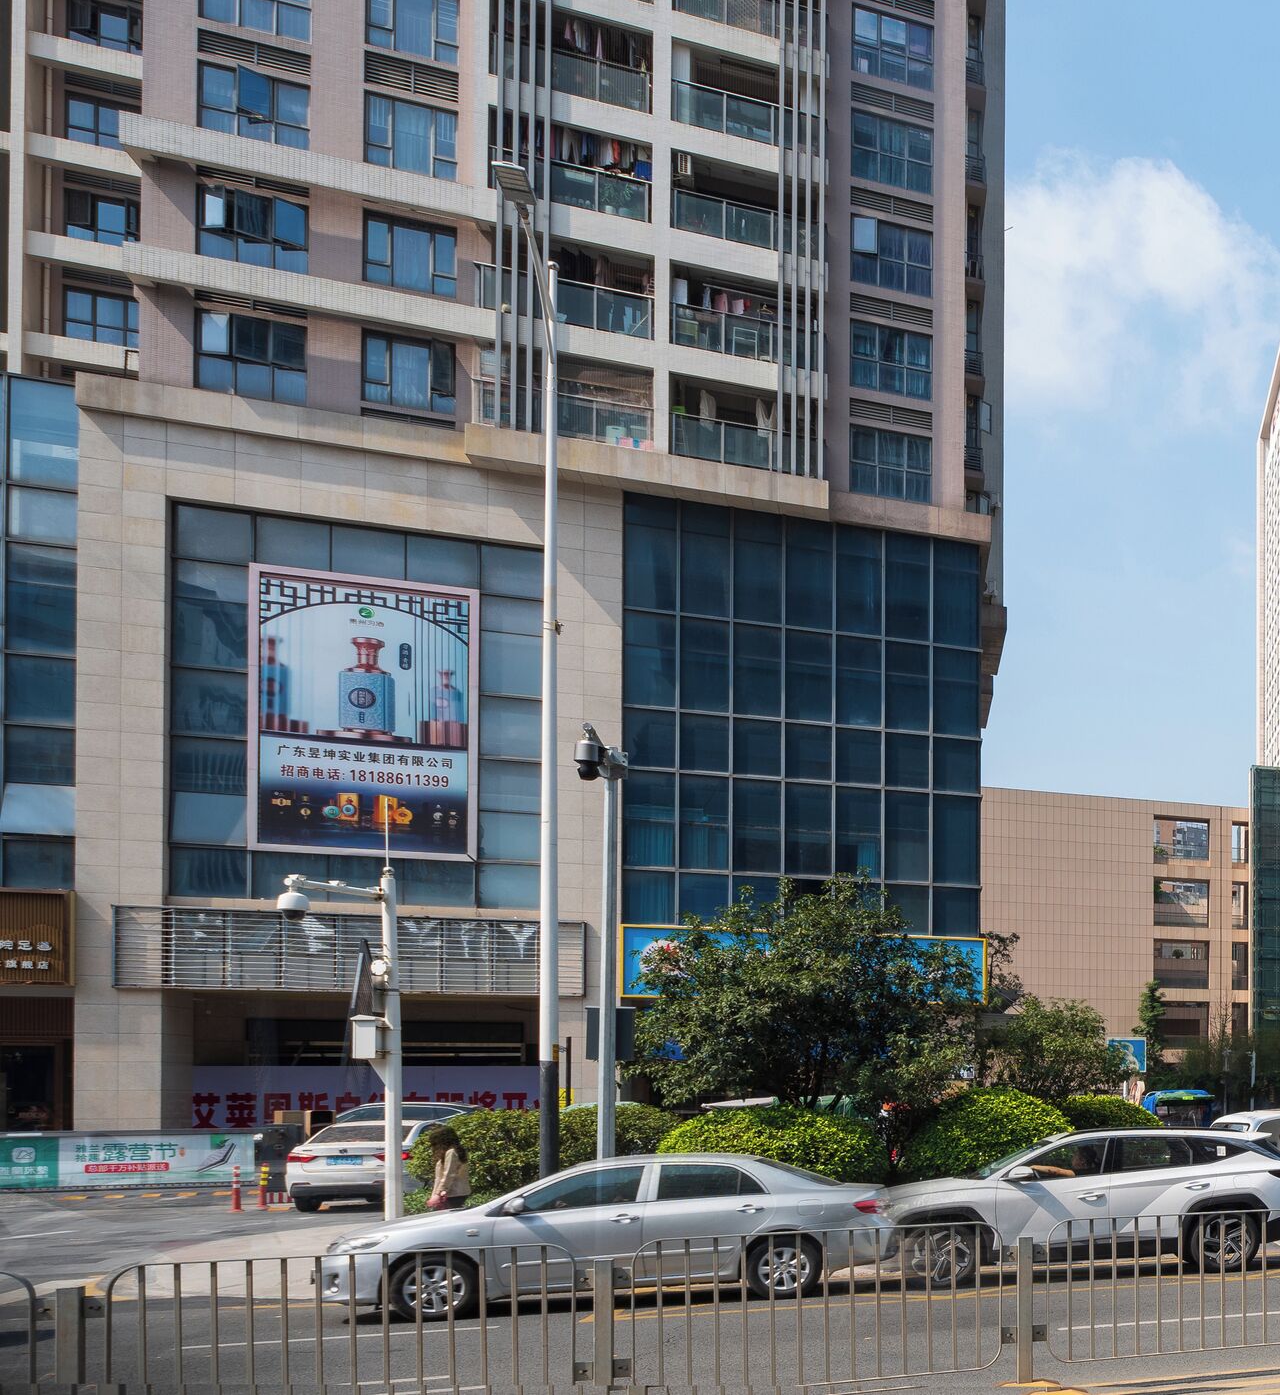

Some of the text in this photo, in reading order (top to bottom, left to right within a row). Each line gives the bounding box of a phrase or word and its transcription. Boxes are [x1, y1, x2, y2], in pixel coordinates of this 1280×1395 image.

[277, 744, 453, 770] 广东昱坤实业集团有限公司
[349, 769, 450, 788] 18188611399
[102, 1142, 179, 1161] 露营节
